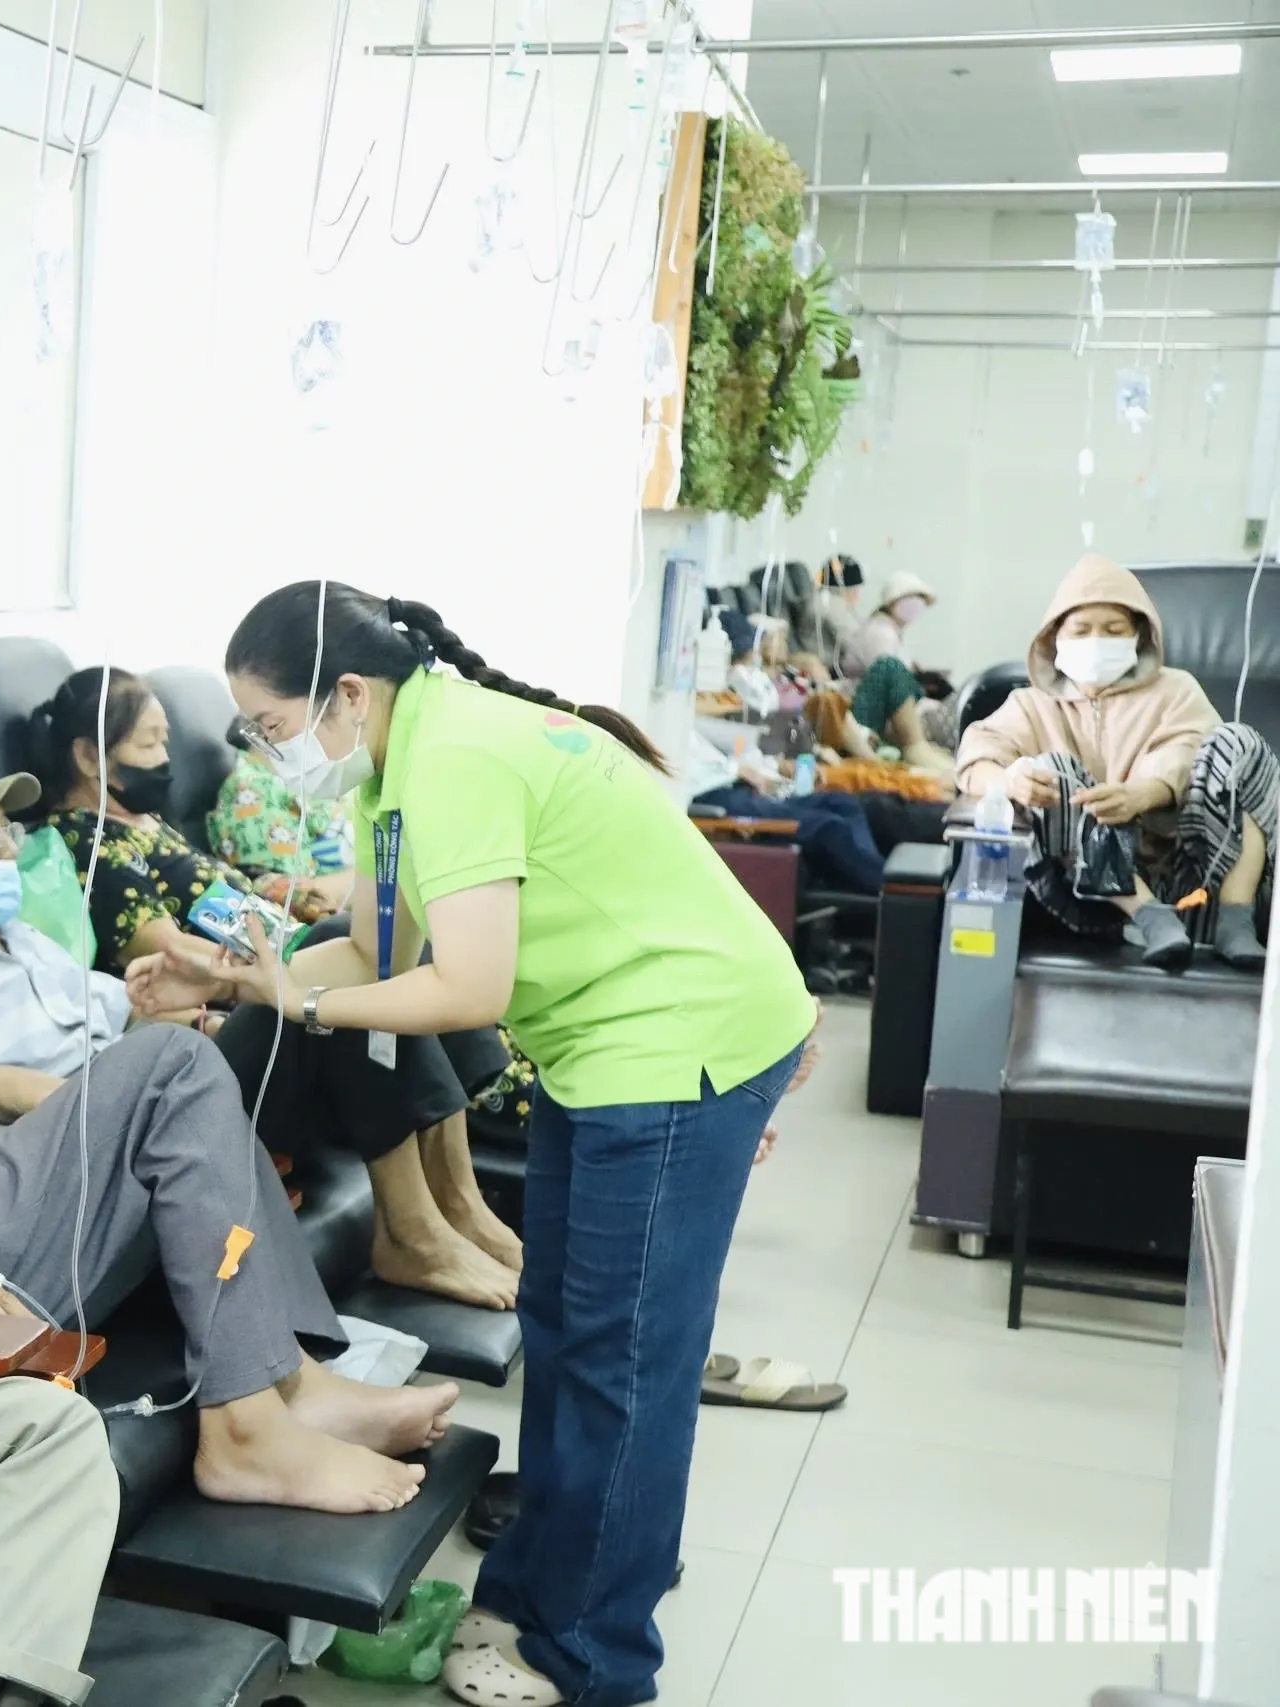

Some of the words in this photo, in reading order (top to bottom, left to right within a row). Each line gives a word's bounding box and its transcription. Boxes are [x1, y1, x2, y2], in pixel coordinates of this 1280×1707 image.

[391, 814, 400, 831] TÁC
[389, 832, 398, 855] CÔNG
[387, 856, 397, 884] PHÒNG
